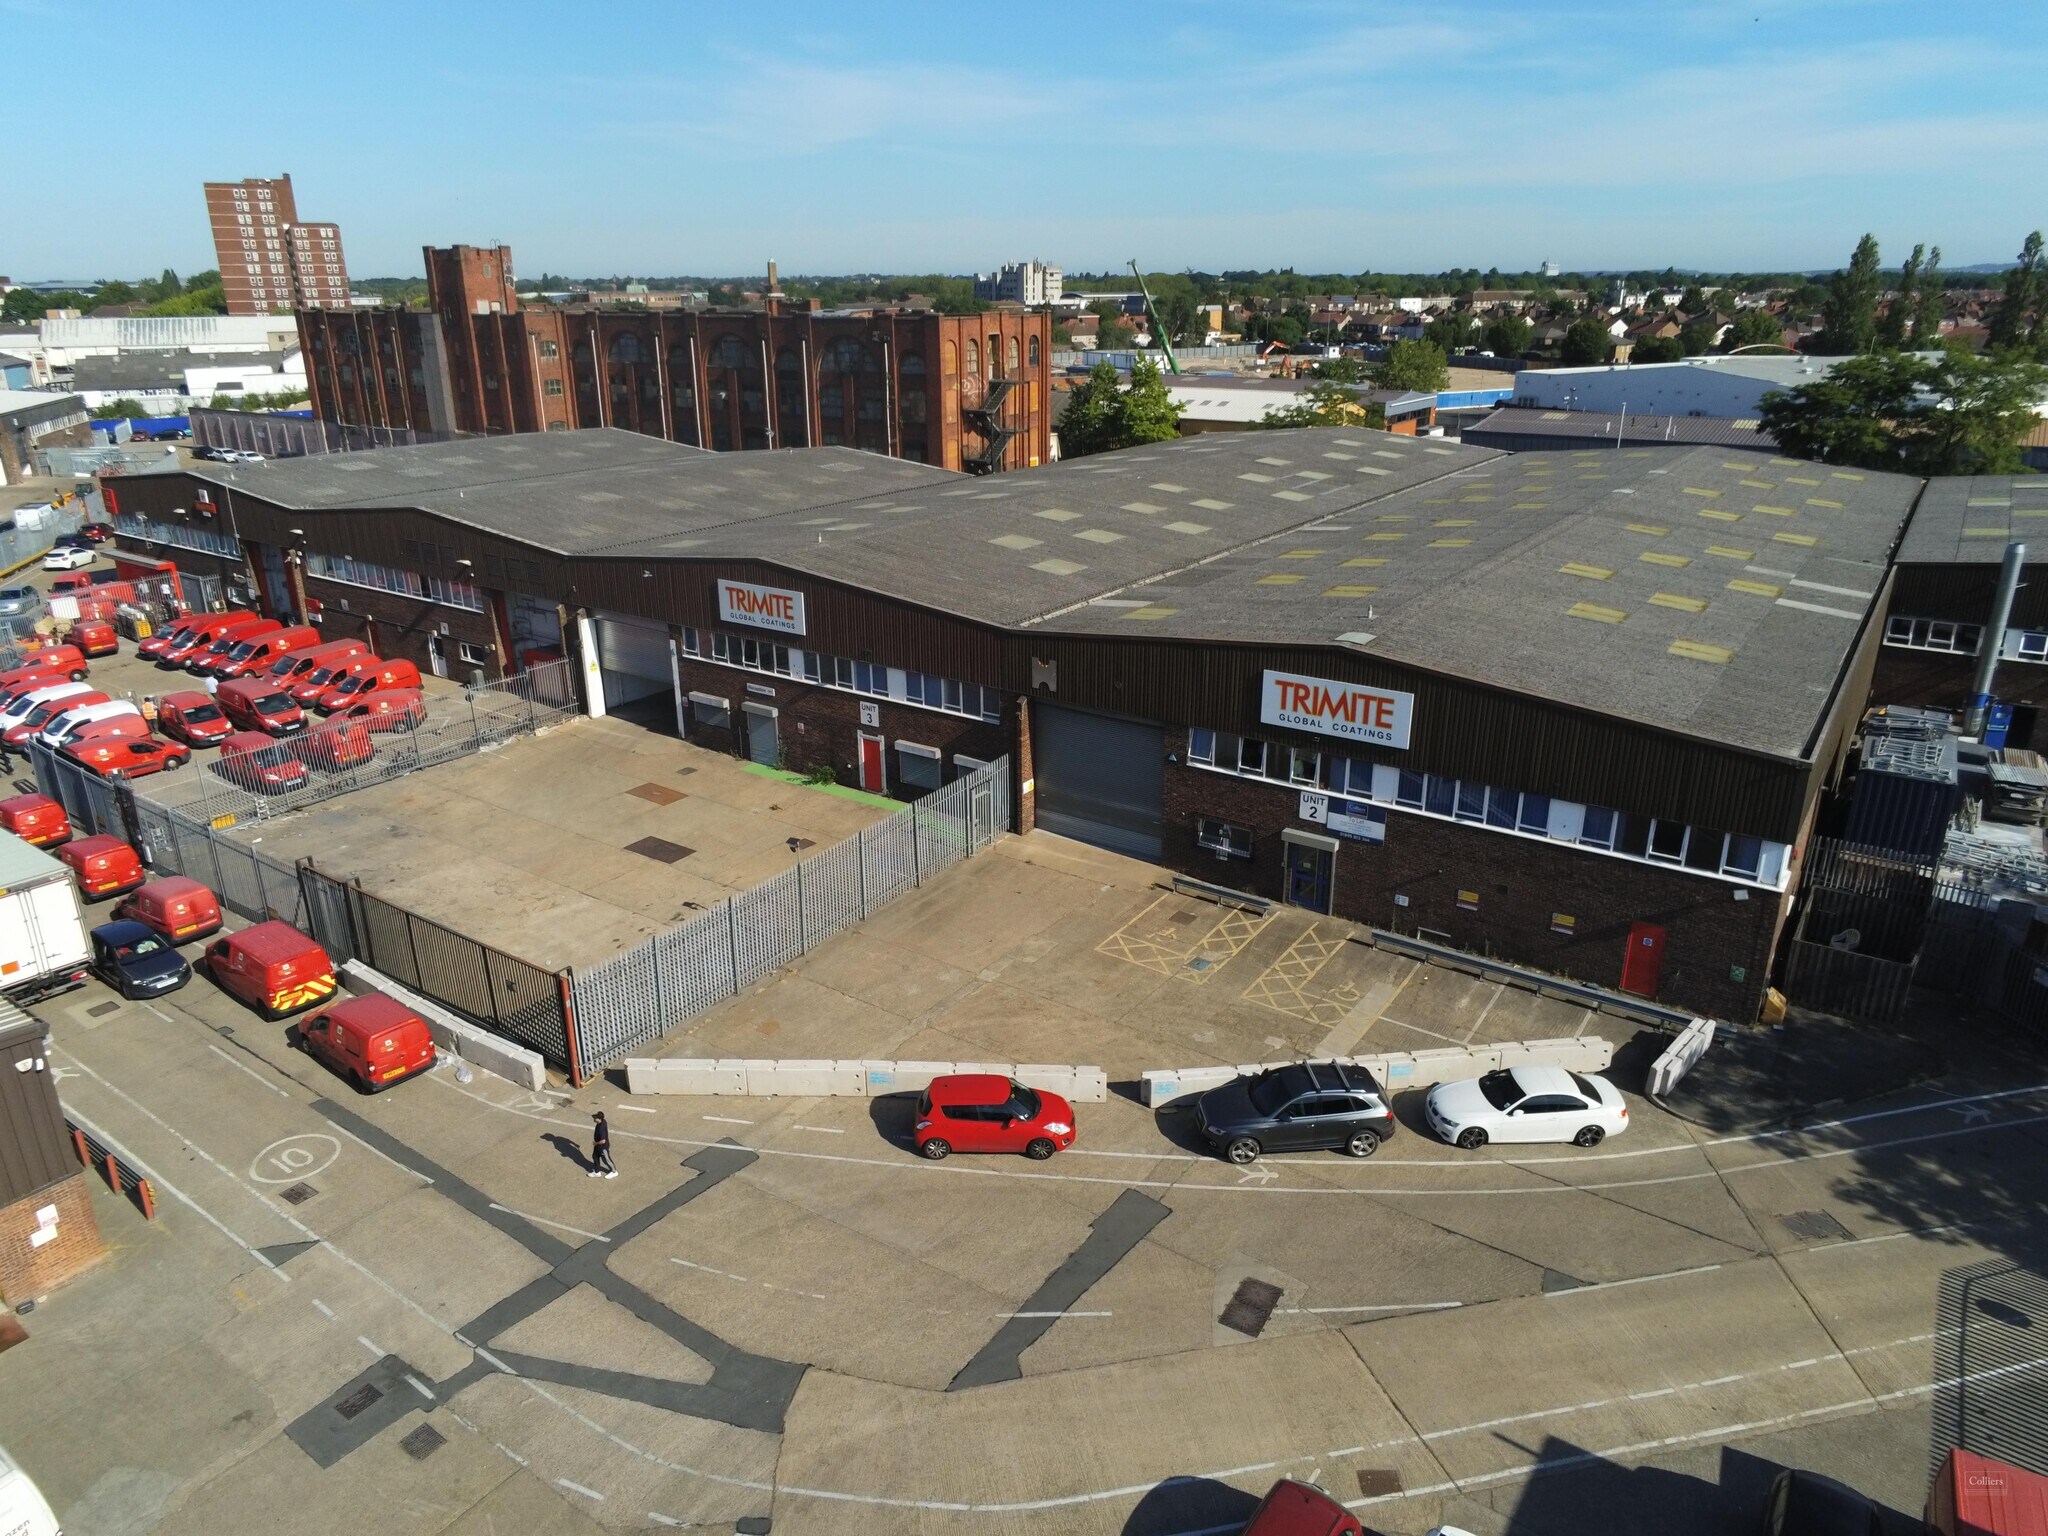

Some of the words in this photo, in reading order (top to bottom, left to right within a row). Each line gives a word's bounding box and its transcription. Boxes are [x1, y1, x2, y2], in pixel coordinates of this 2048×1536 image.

[725, 586, 794, 620] TRIMITE
[730, 612, 756, 622] GLOBAL
[761, 617, 796, 630] COATINGS
[862, 703, 876, 713] UNIT
[1275, 680, 1395, 729] TRIMITE
[867, 712, 873, 724] 3
[1279, 713, 1323, 728] GLOBAL
[1332, 723, 1392, 741] COATINGS
[1302, 794, 1326, 806] UNIT
[1309, 806, 1318, 819] 2
[269, 1147, 314, 1174] 10
